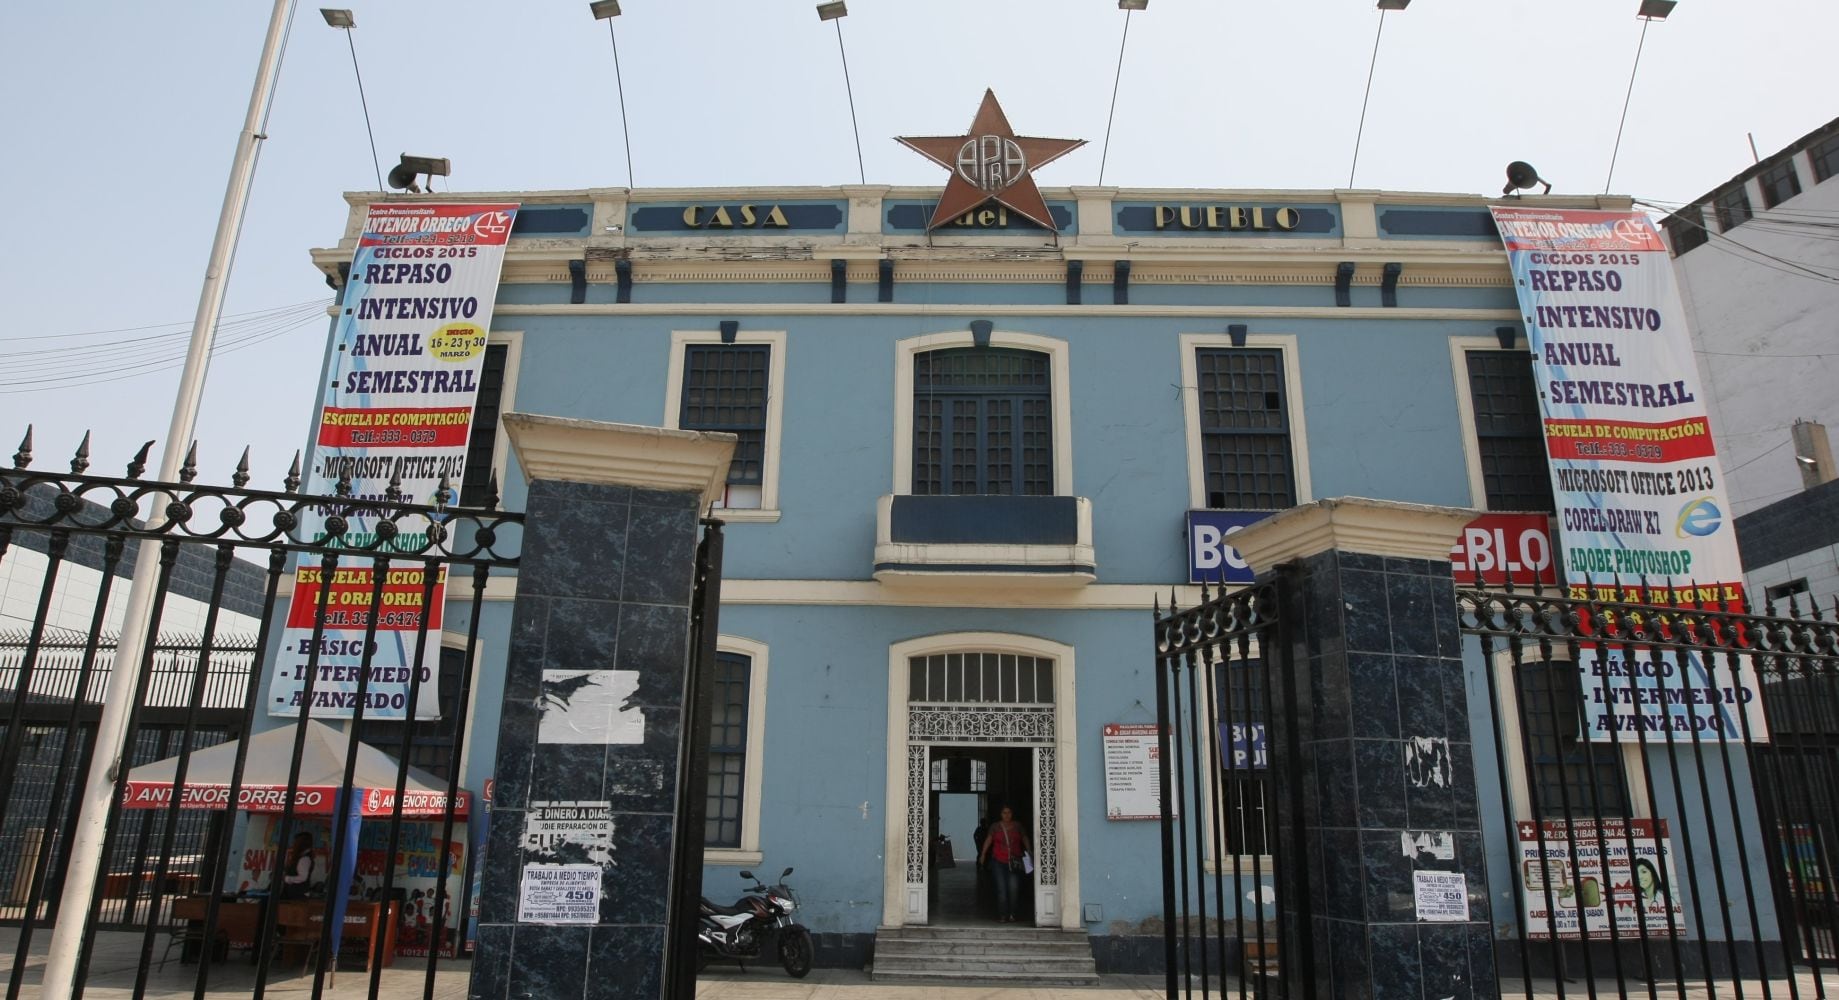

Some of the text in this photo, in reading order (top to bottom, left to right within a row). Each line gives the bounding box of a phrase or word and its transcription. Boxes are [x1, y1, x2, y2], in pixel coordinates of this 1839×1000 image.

[363, 217, 471, 233] ANTENOR ORREGO
[683, 204, 789, 226] CASA
[1155, 205, 1300, 229] PUEBLO
[1501, 220, 1612, 239] ANTENOR ORREGO
[373, 248, 477, 258] CICLOS 2015
[1530, 253, 1640, 265] CICLOS 2015
[364, 263, 451, 284] REPASO
[1529, 269, 1622, 292] REPASO
[357, 297, 477, 320] INTENSIVO
[1536, 306, 1661, 331] INTENSIVO
[350, 333, 423, 356] ANUAL
[431, 338, 442, 348] 16
[450, 337, 463, 348] 23
[464, 340, 471, 350] y
[473, 337, 486, 347] 30
[1544, 343, 1621, 367] ANUAL
[345, 370, 476, 394] SEMESTRAL
[1549, 380, 1695, 408] SEMESTRAL
[322, 408, 471, 426] ESCUELA DE COMPUTACIÓN
[381, 430, 401, 442] 333
[410, 430, 435, 442] 0379
[1545, 420, 1704, 440] ESCUELA DE COMPUTACIÓN
[1609, 443, 1628, 456] 333
[1636, 443, 1662, 458] 0379
[1557, 466, 1714, 496] MICROSOFT OFFICE 2013
[1564, 507, 1607, 531] COREL
[1607, 508, 1642, 534] DRAW
[1569, 548, 1692, 575] ADOBE PHOTOSHOP
[341, 591, 423, 606] ORAORIA
[294, 665, 431, 684] ITERMEDO
[1591, 656, 1674, 677] BÁSICO
[381, 794, 465, 809] ANENOR ORRGO
[545, 809, 578, 819] DINERO
[580, 809, 586, 819] A
[556, 822, 597, 830] REPARACIÓN
[1617, 828, 1645, 836] ACSTA
[1613, 846, 1668, 857] INYCTABLS
[528, 871, 599, 880] TRABAJO A MEDIO TIEMPO
[565, 891, 594, 899] 450
